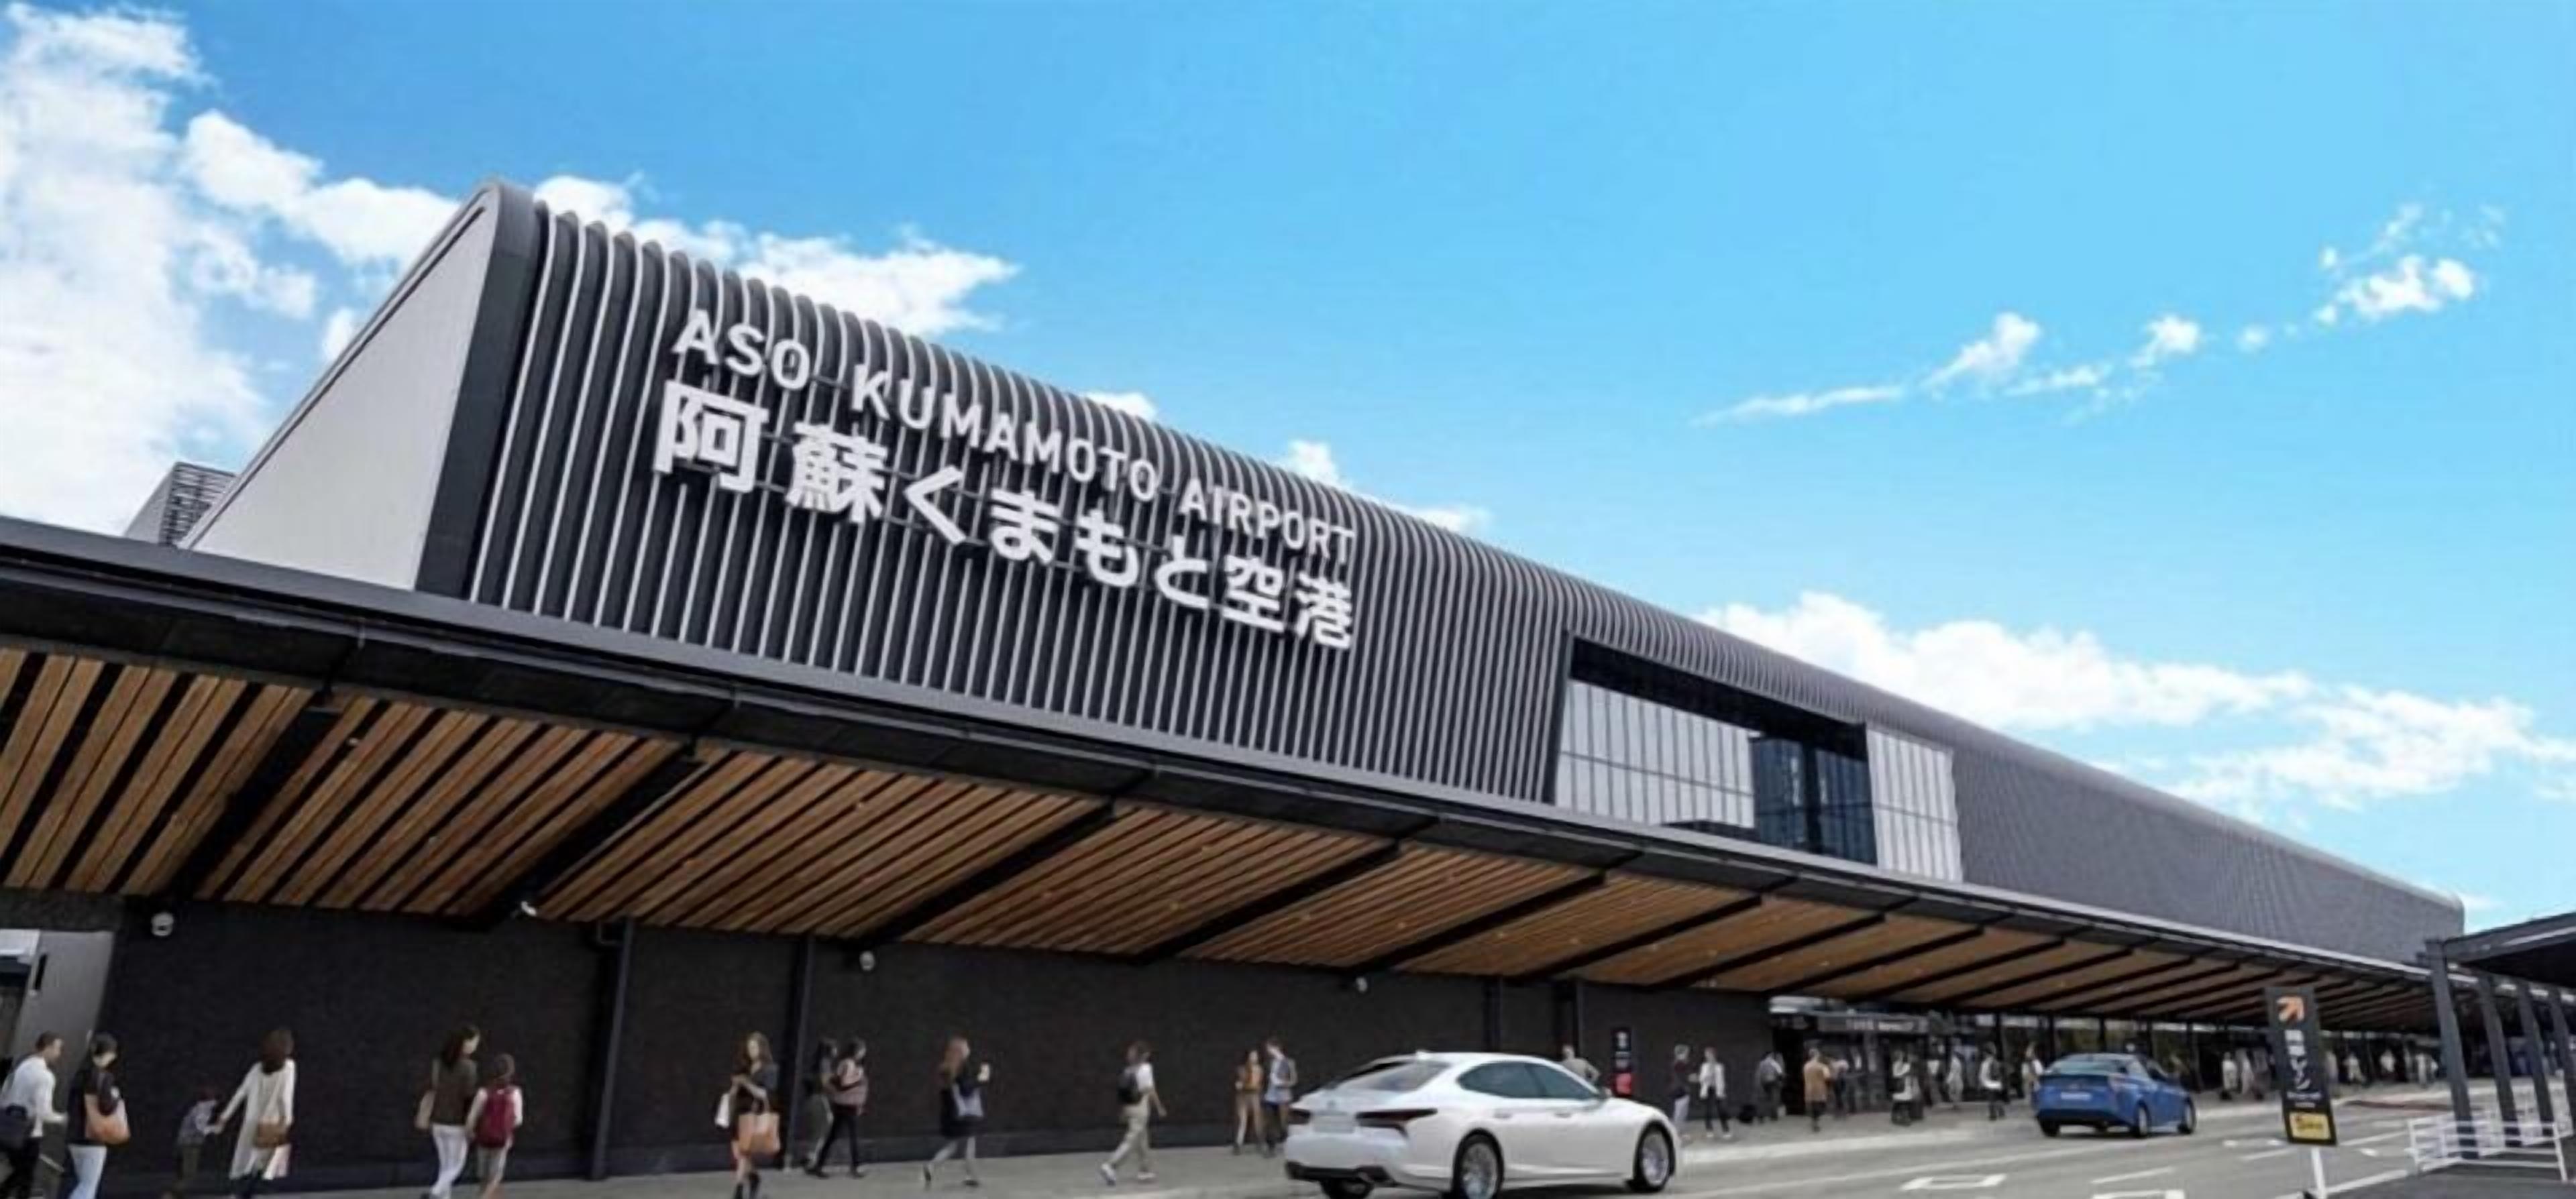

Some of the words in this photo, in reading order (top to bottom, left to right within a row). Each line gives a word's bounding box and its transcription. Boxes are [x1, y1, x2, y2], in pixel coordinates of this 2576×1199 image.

[653, 380, 1352, 649] 阿蘇くまもと空港
[672, 309, 810, 390] ASO
[851, 363, 1157, 502] KUMAMOTO
[1178, 477, 1355, 564] AIRPORT
